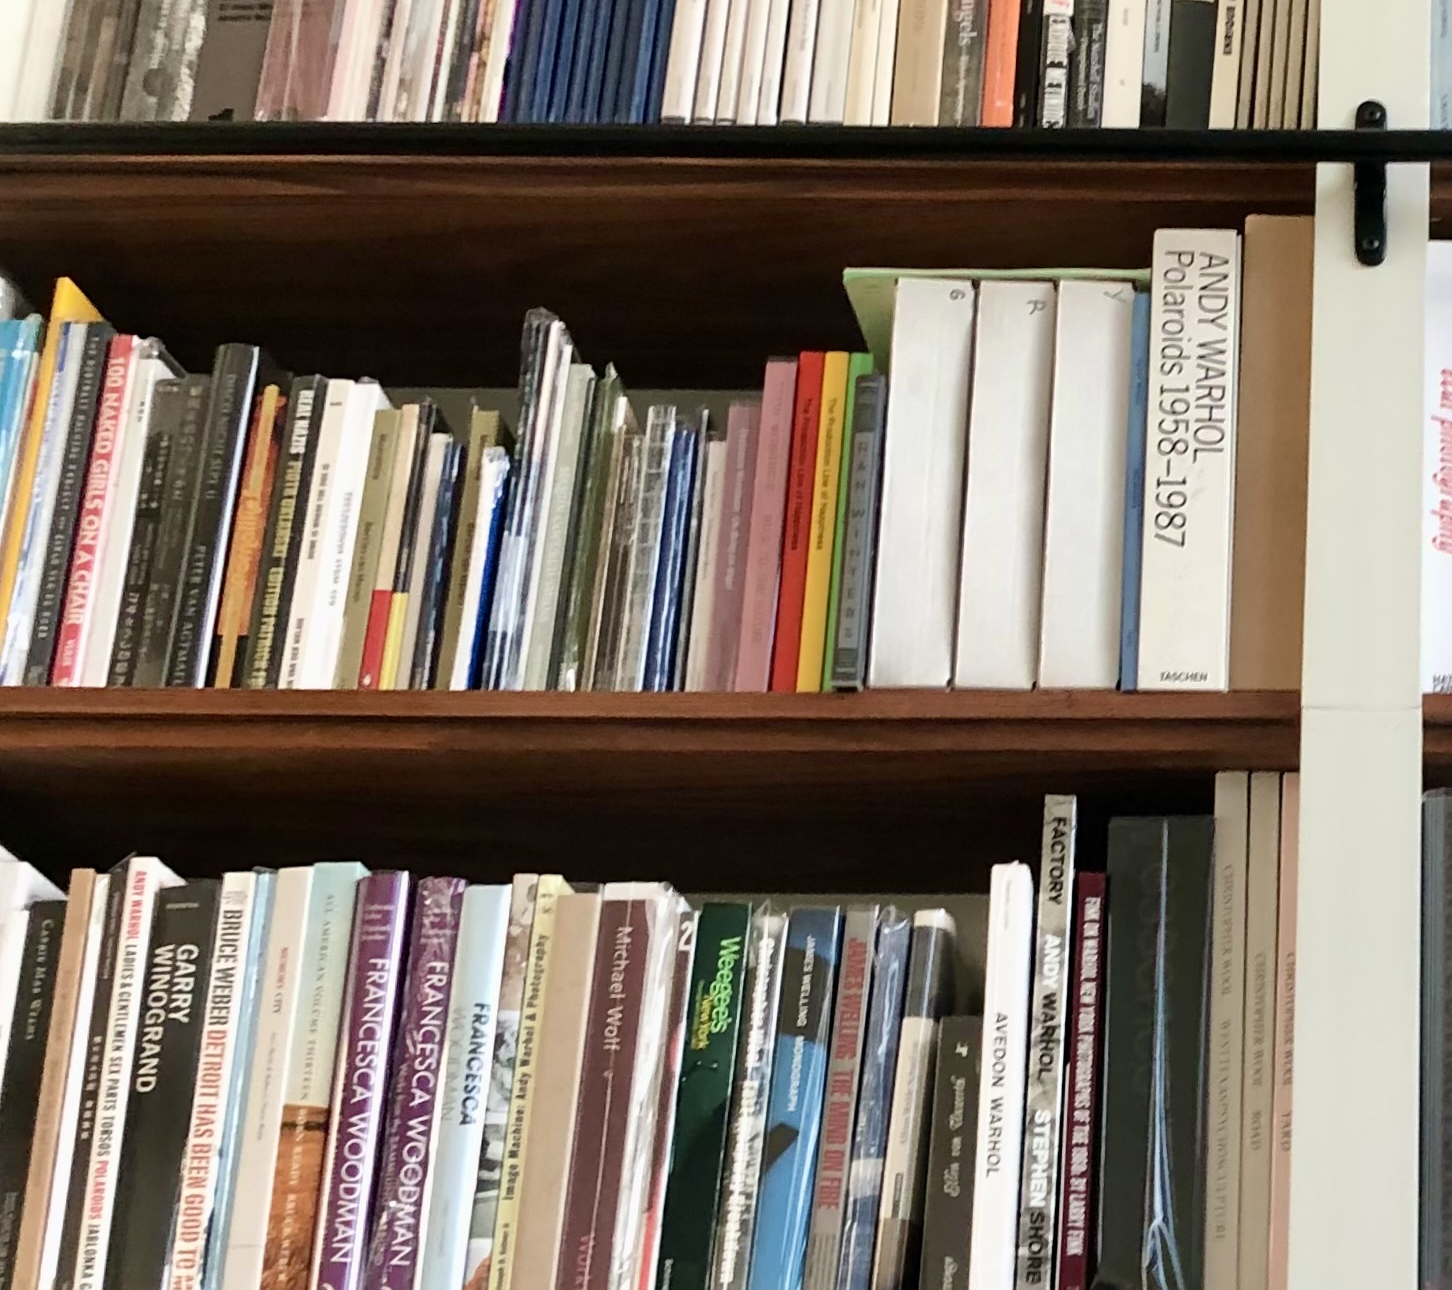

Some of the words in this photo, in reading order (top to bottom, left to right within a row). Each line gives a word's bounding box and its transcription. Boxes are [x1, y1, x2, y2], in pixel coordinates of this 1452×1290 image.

[1159, 250, 1194, 377] Polaroids
[1198, 251, 1229, 331] ANDY
[106, 356, 128, 388] 100
[1191, 338, 1227, 464] WARHOL
[94, 393, 121, 455] NAKED
[85, 458, 110, 512] GIRLS
[76, 549, 96, 563] A
[80, 515, 101, 545] ON
[190, 545, 208, 585] PETER
[66, 568, 94, 625] CHAIR
[183, 589, 200, 617] VAN
[1159, 671, 1208, 683] TASCHEN
[1047, 816, 1068, 905] FACTORY
[215, 909, 244, 964] BRUCE
[608, 926, 634, 999] Michael
[1040, 934, 1061, 990] ANDY
[135, 943, 177, 1093] WINOGRAND
[168, 943, 200, 1024] GARRY
[208, 966, 237, 1026] WEBER
[710, 936, 742, 1033] Weegee's
[349, 957, 390, 1103] FRANCESCA
[408, 961, 448, 1107] FRANCESCA
[602, 1005, 627, 1052] Wolf
[990, 1012, 1009, 1089] AVEDON
[1036, 992, 1058, 1080] WARHOL
[198, 1030, 228, 1099] DETROIT
[458, 1002, 491, 1127] FRANCESCA
[193, 1103, 218, 1139] HAS
[985, 1096, 1005, 1179] WARHOL
[185, 1142, 214, 1190] BEEN
[330, 1114, 371, 1264] WOODMAN
[389, 1116, 430, 1267] WOODMAN
[1028, 1108, 1050, 1208] STEPHEN
[179, 1193, 206, 1242] GOOD
[1024, 1210, 1046, 1286] SHORE
[176, 1248, 199, 1270] TO
